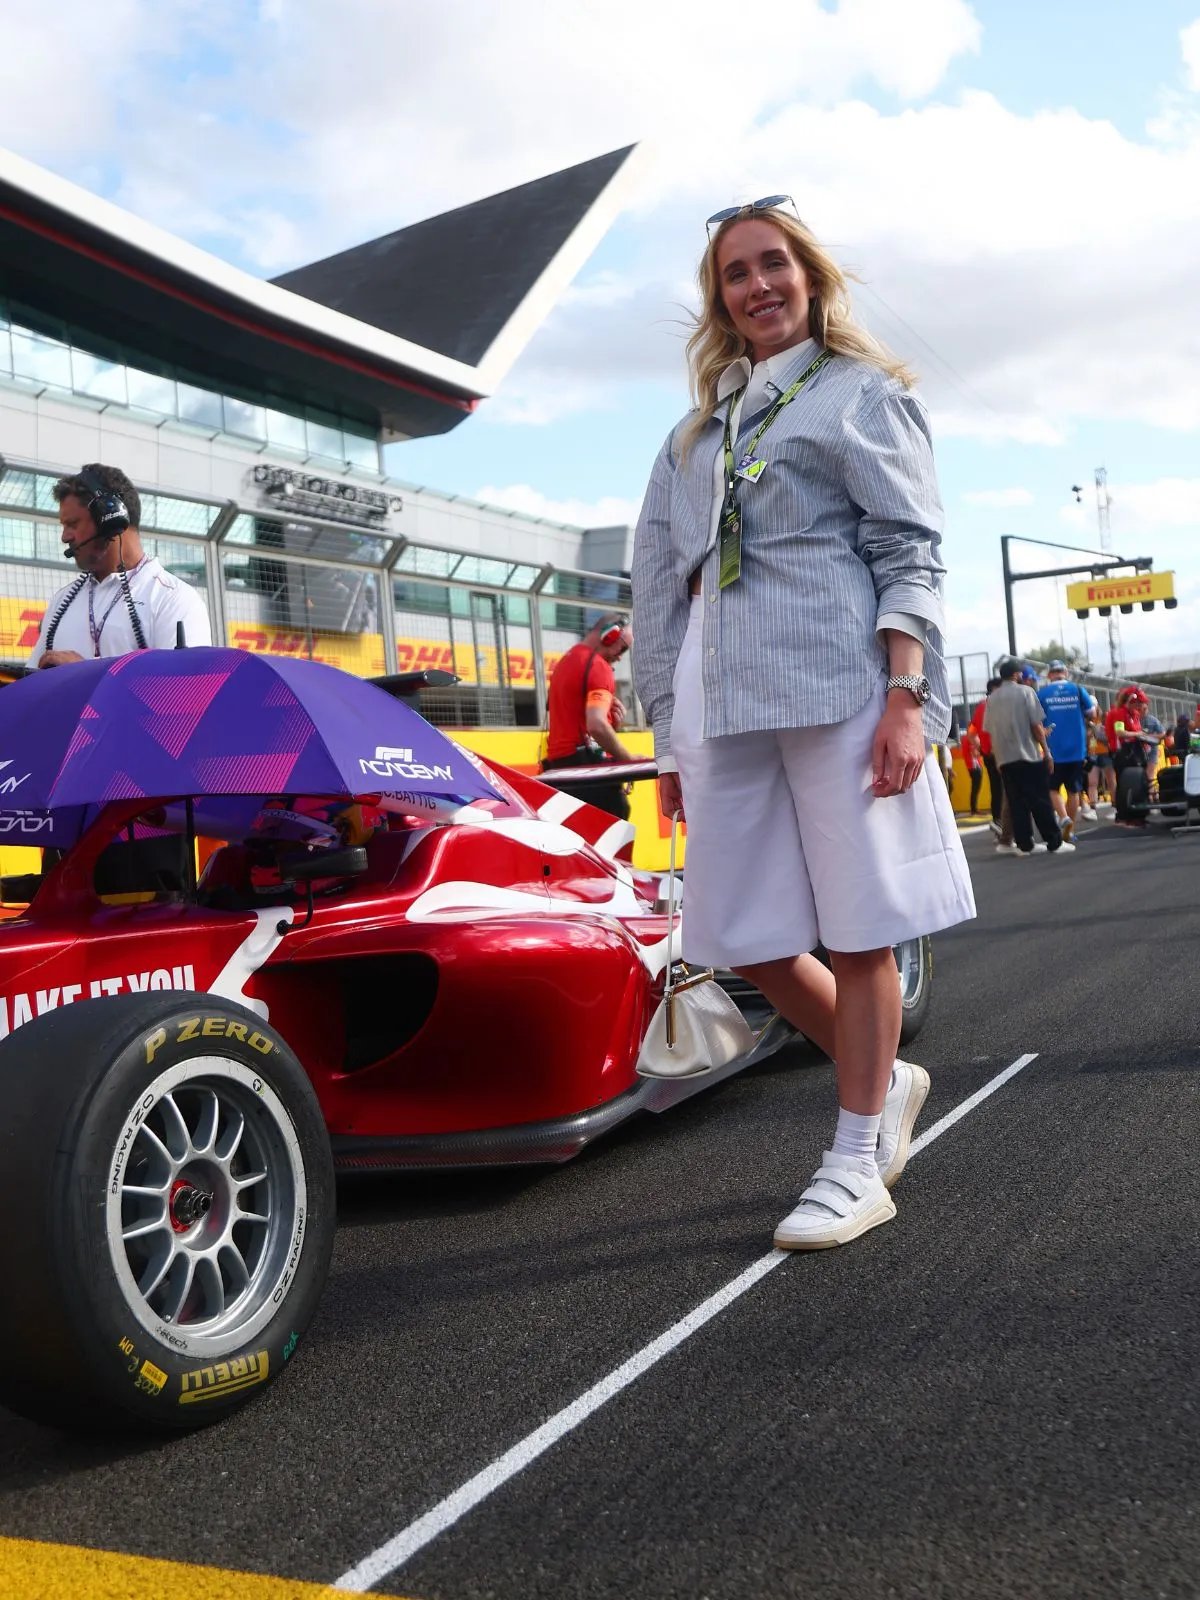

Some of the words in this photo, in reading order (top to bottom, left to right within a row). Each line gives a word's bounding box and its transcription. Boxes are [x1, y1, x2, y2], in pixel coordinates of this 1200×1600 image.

[1088, 579, 1151, 602] PIRELLI
[359, 758, 455, 781] ACADEMY
[145, 1027, 167, 1064] P
[176, 1017, 274, 1055] ZERO
[111, 1127, 133, 1195] RACING
[289, 1207, 304, 1268] RACING
[178, 1349, 270, 1405] PIRELLI
